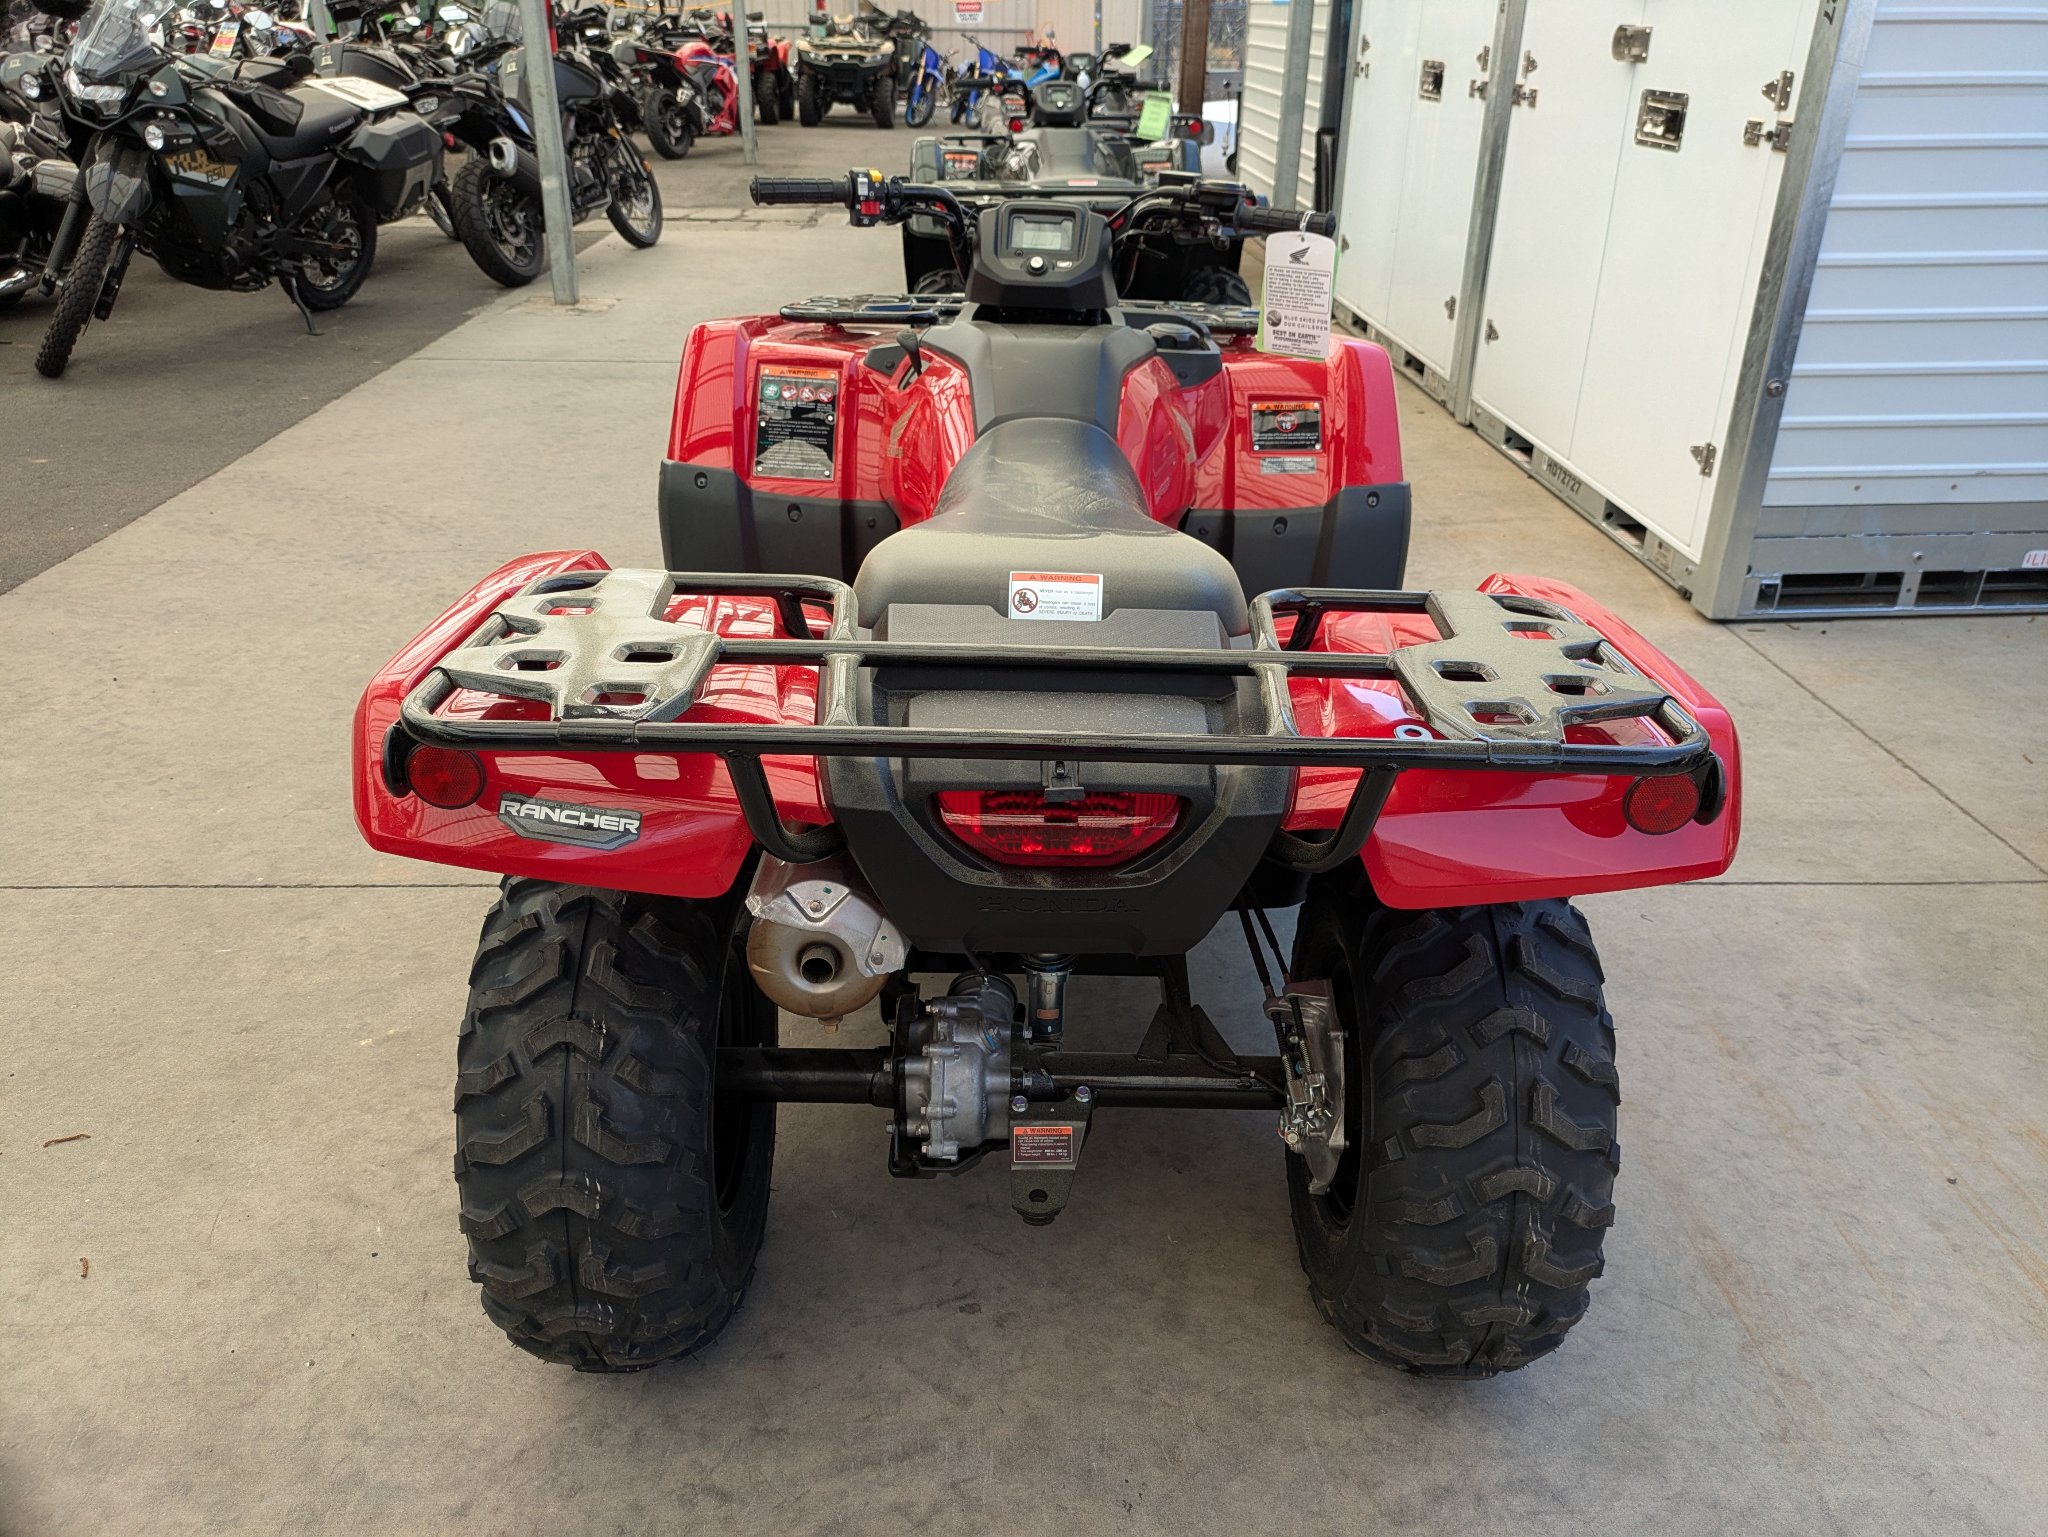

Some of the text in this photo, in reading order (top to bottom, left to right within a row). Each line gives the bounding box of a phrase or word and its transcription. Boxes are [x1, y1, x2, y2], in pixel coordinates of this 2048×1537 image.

[206, 165, 227, 184] 650
[1282, 422, 1292, 430] 16
[1040, 574, 1082, 582] WARNING
[500, 800, 640, 833] RANCHER
[977, 895, 1142, 913] HONDA
